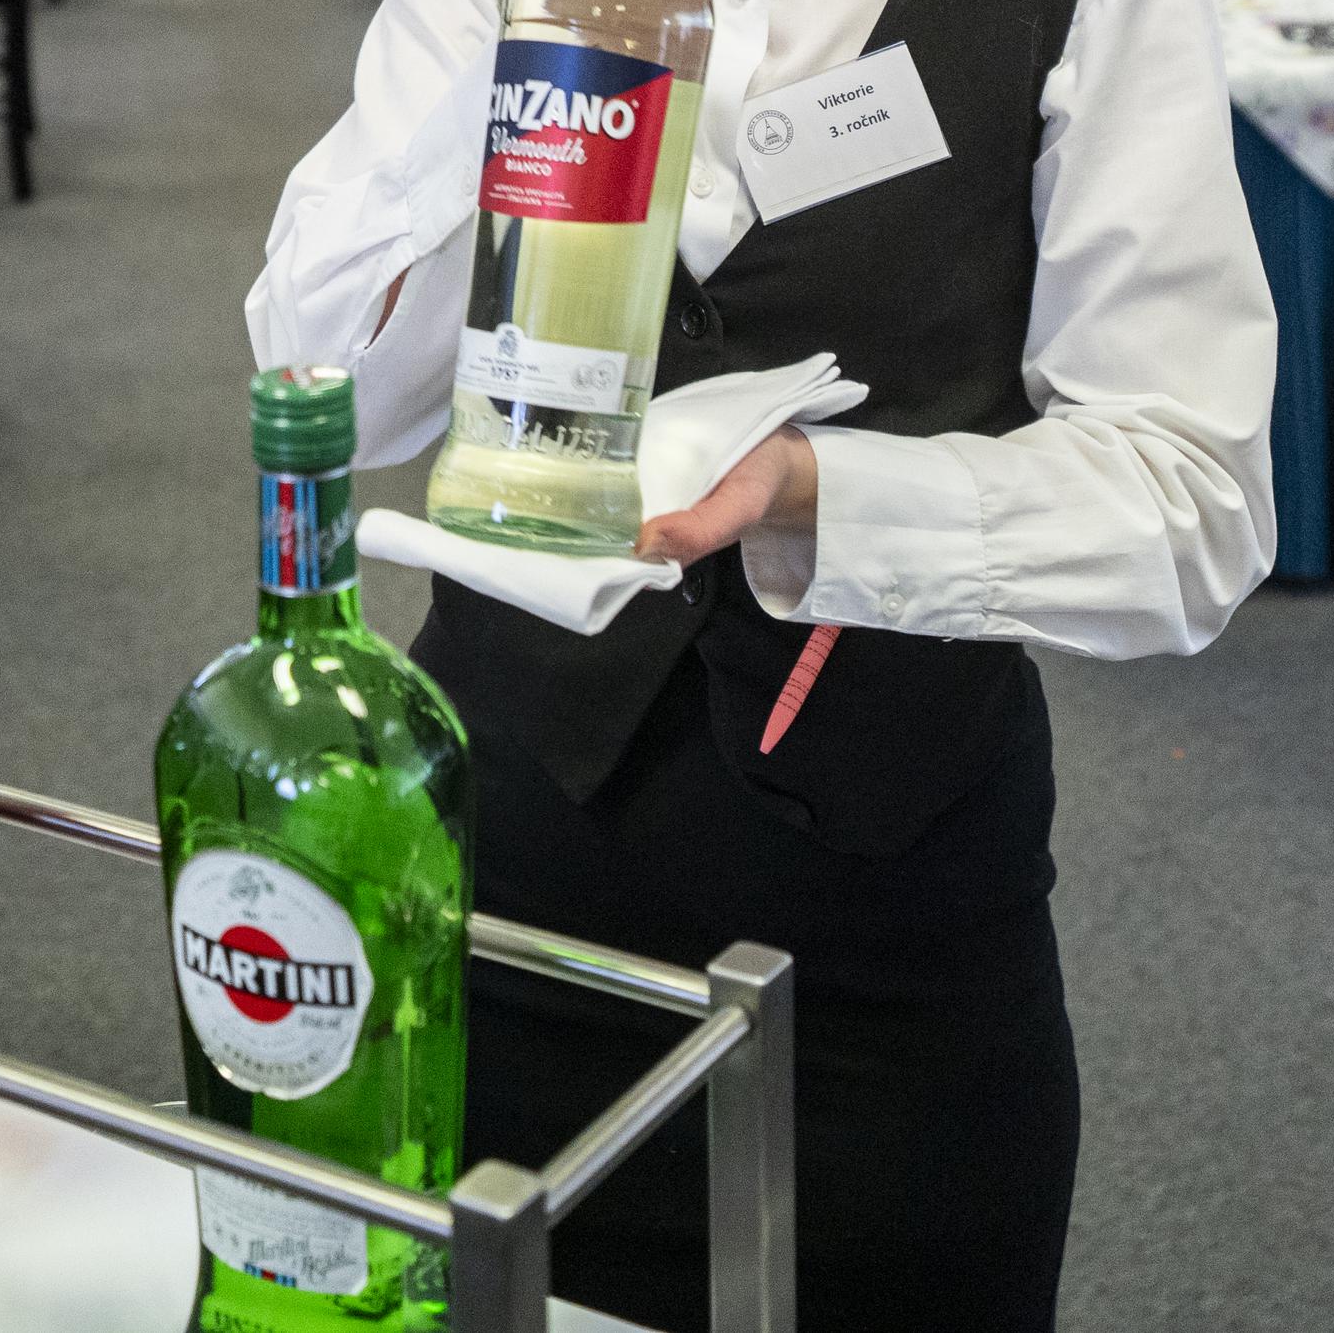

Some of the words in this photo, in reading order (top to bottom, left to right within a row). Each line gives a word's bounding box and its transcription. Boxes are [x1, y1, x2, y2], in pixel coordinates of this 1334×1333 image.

[818, 83, 875, 110] Viktorie
[829, 126, 844, 138] 3.
[847, 108, 890, 133] ročník
[492, 125, 587, 165] Vermouth
[185, 929, 351, 1006] MARTINI
